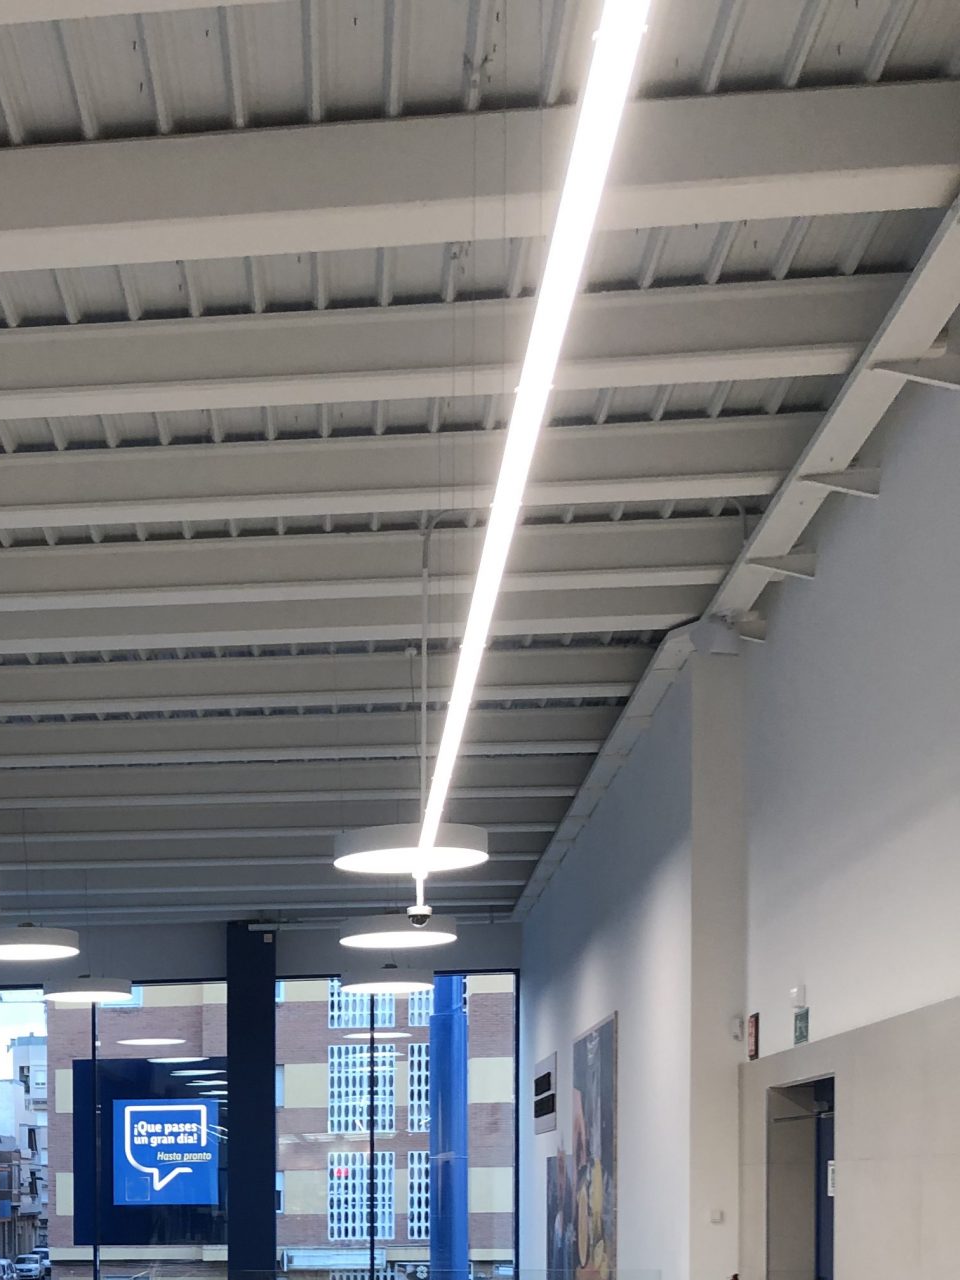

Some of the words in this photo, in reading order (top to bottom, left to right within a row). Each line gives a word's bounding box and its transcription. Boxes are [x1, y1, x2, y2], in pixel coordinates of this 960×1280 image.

[134, 1121, 162, 1135] ¡Que
[164, 1123, 198, 1135] pases
[134, 1135, 148, 1145] un
[150, 1135, 175, 1147] gran
[177, 1132, 198, 1144] día!
[157, 1152, 181, 1160] Hasta
[184, 1152, 212, 1161] pronto
